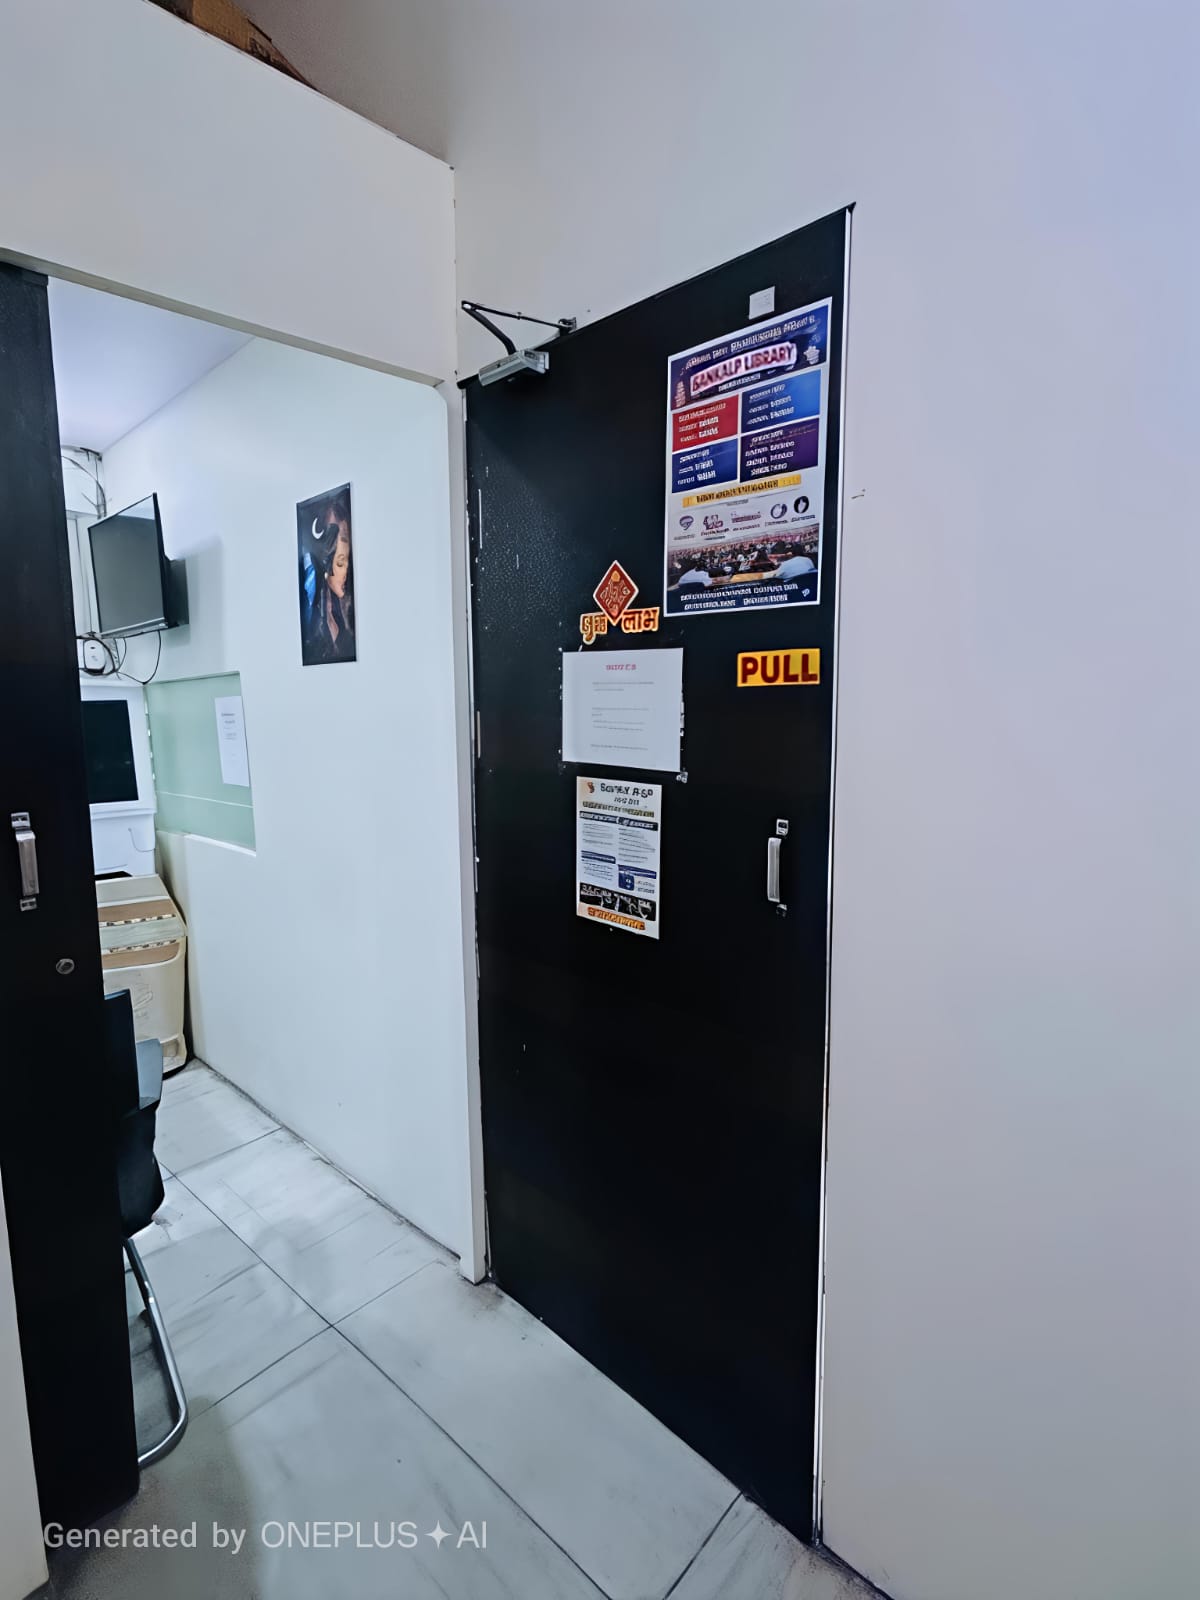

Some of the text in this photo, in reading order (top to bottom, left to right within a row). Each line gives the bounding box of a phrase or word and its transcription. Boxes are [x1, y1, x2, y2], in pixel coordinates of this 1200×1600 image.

[744, 345, 794, 371] LIBRARY
[622, 608, 659, 632] लाभ
[741, 653, 818, 684] PULL
